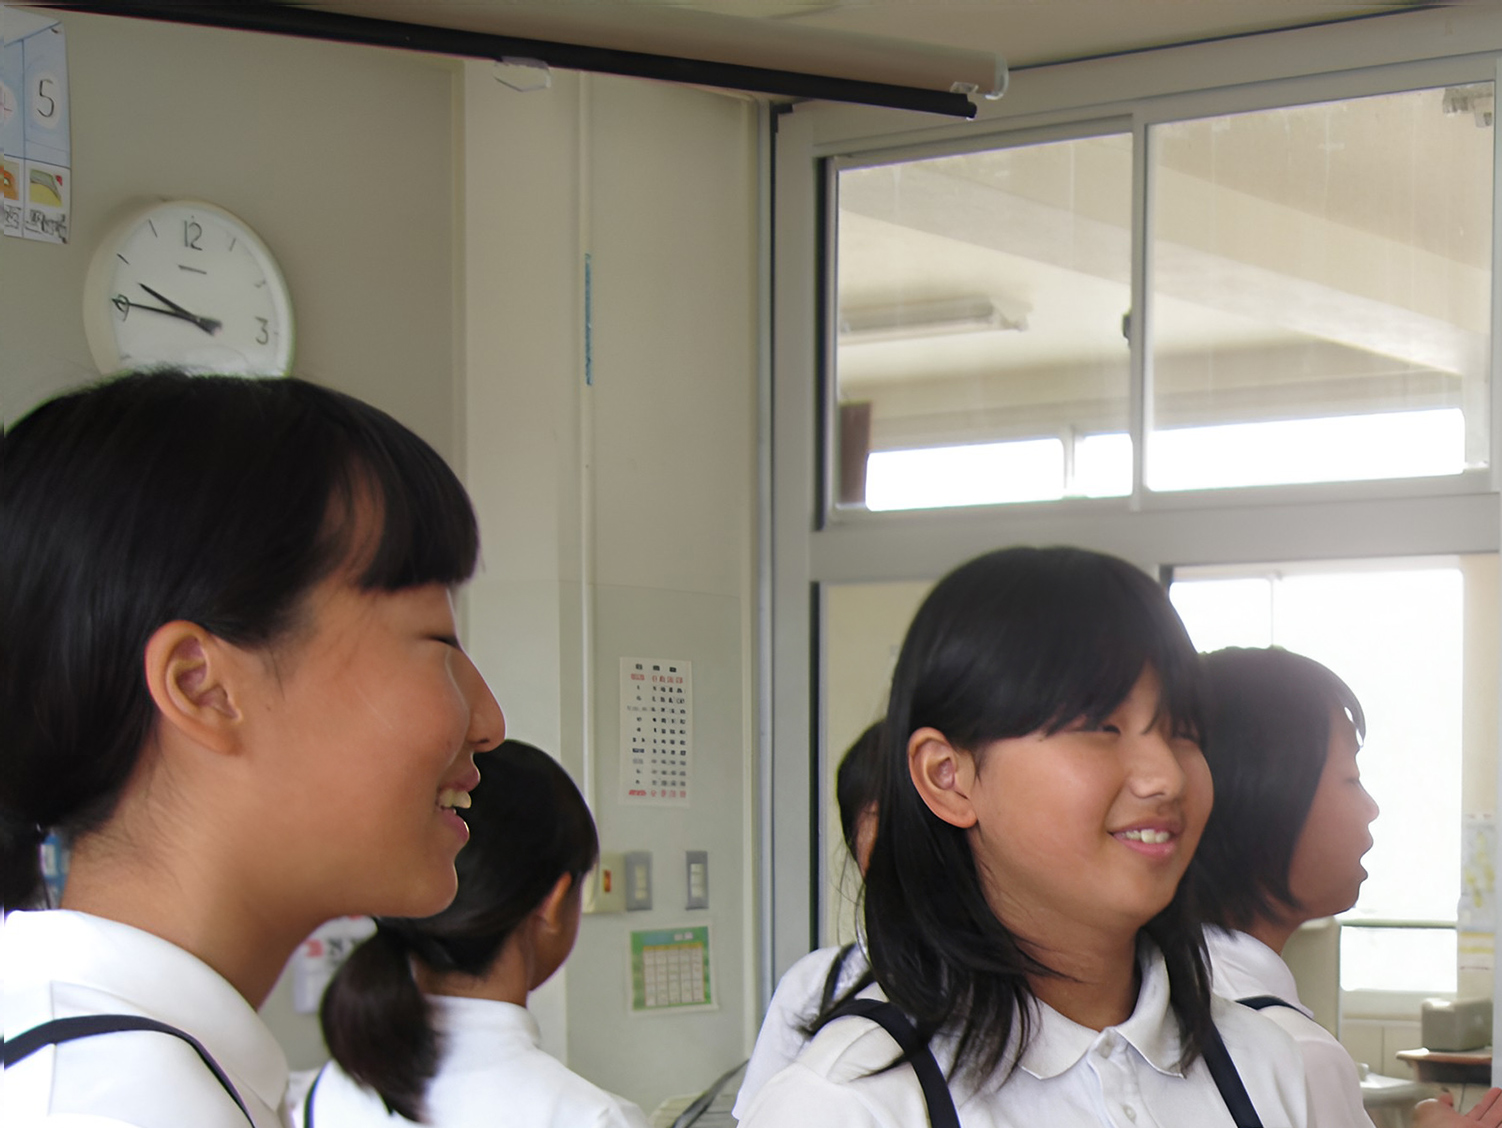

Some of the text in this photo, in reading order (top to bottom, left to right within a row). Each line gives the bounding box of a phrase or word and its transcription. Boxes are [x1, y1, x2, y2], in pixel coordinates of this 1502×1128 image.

[37, 78, 55, 118] 5
[183, 219, 204, 251] 12
[254, 316, 269, 346] 3
